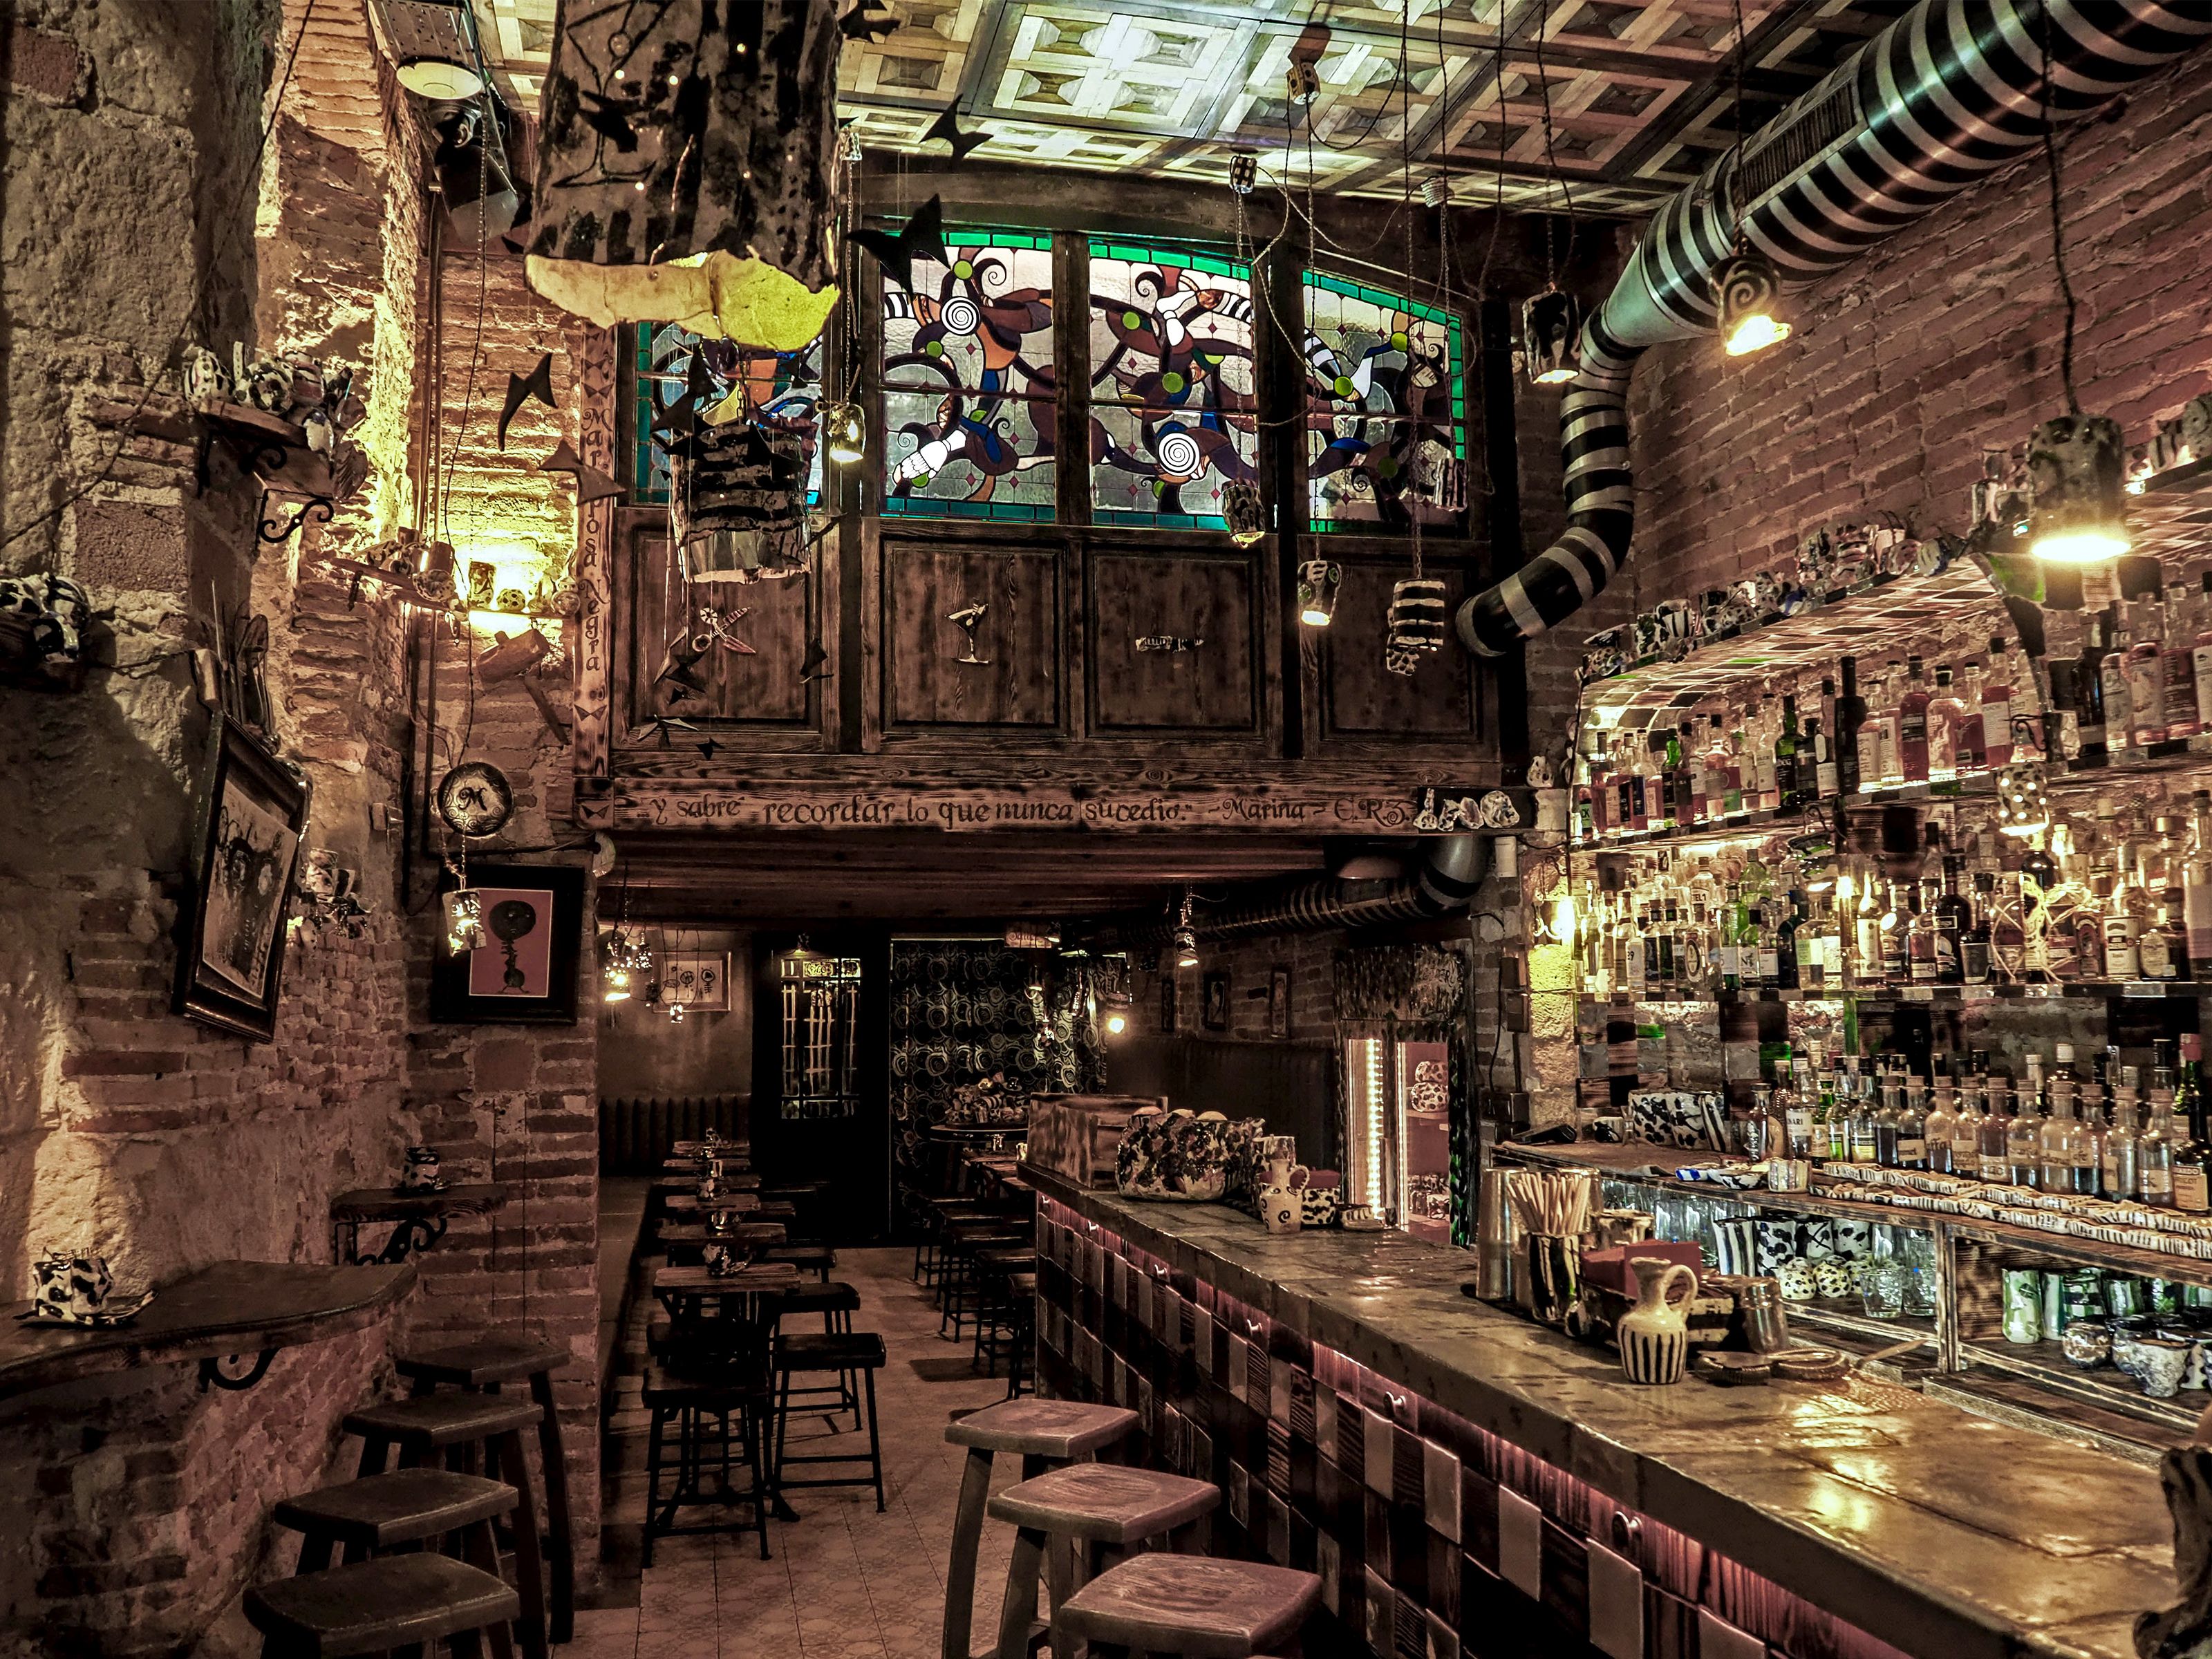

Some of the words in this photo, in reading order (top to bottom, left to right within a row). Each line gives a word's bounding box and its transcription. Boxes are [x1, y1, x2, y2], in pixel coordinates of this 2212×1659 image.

[581, 408, 612, 568] Marposa
[579, 579, 610, 671] Negra
[677, 794, 745, 818] sabré
[763, 794, 895, 824] recordar
[907, 797, 929, 823] lo
[938, 802, 991, 830] que
[995, 801, 1074, 821] nunca
